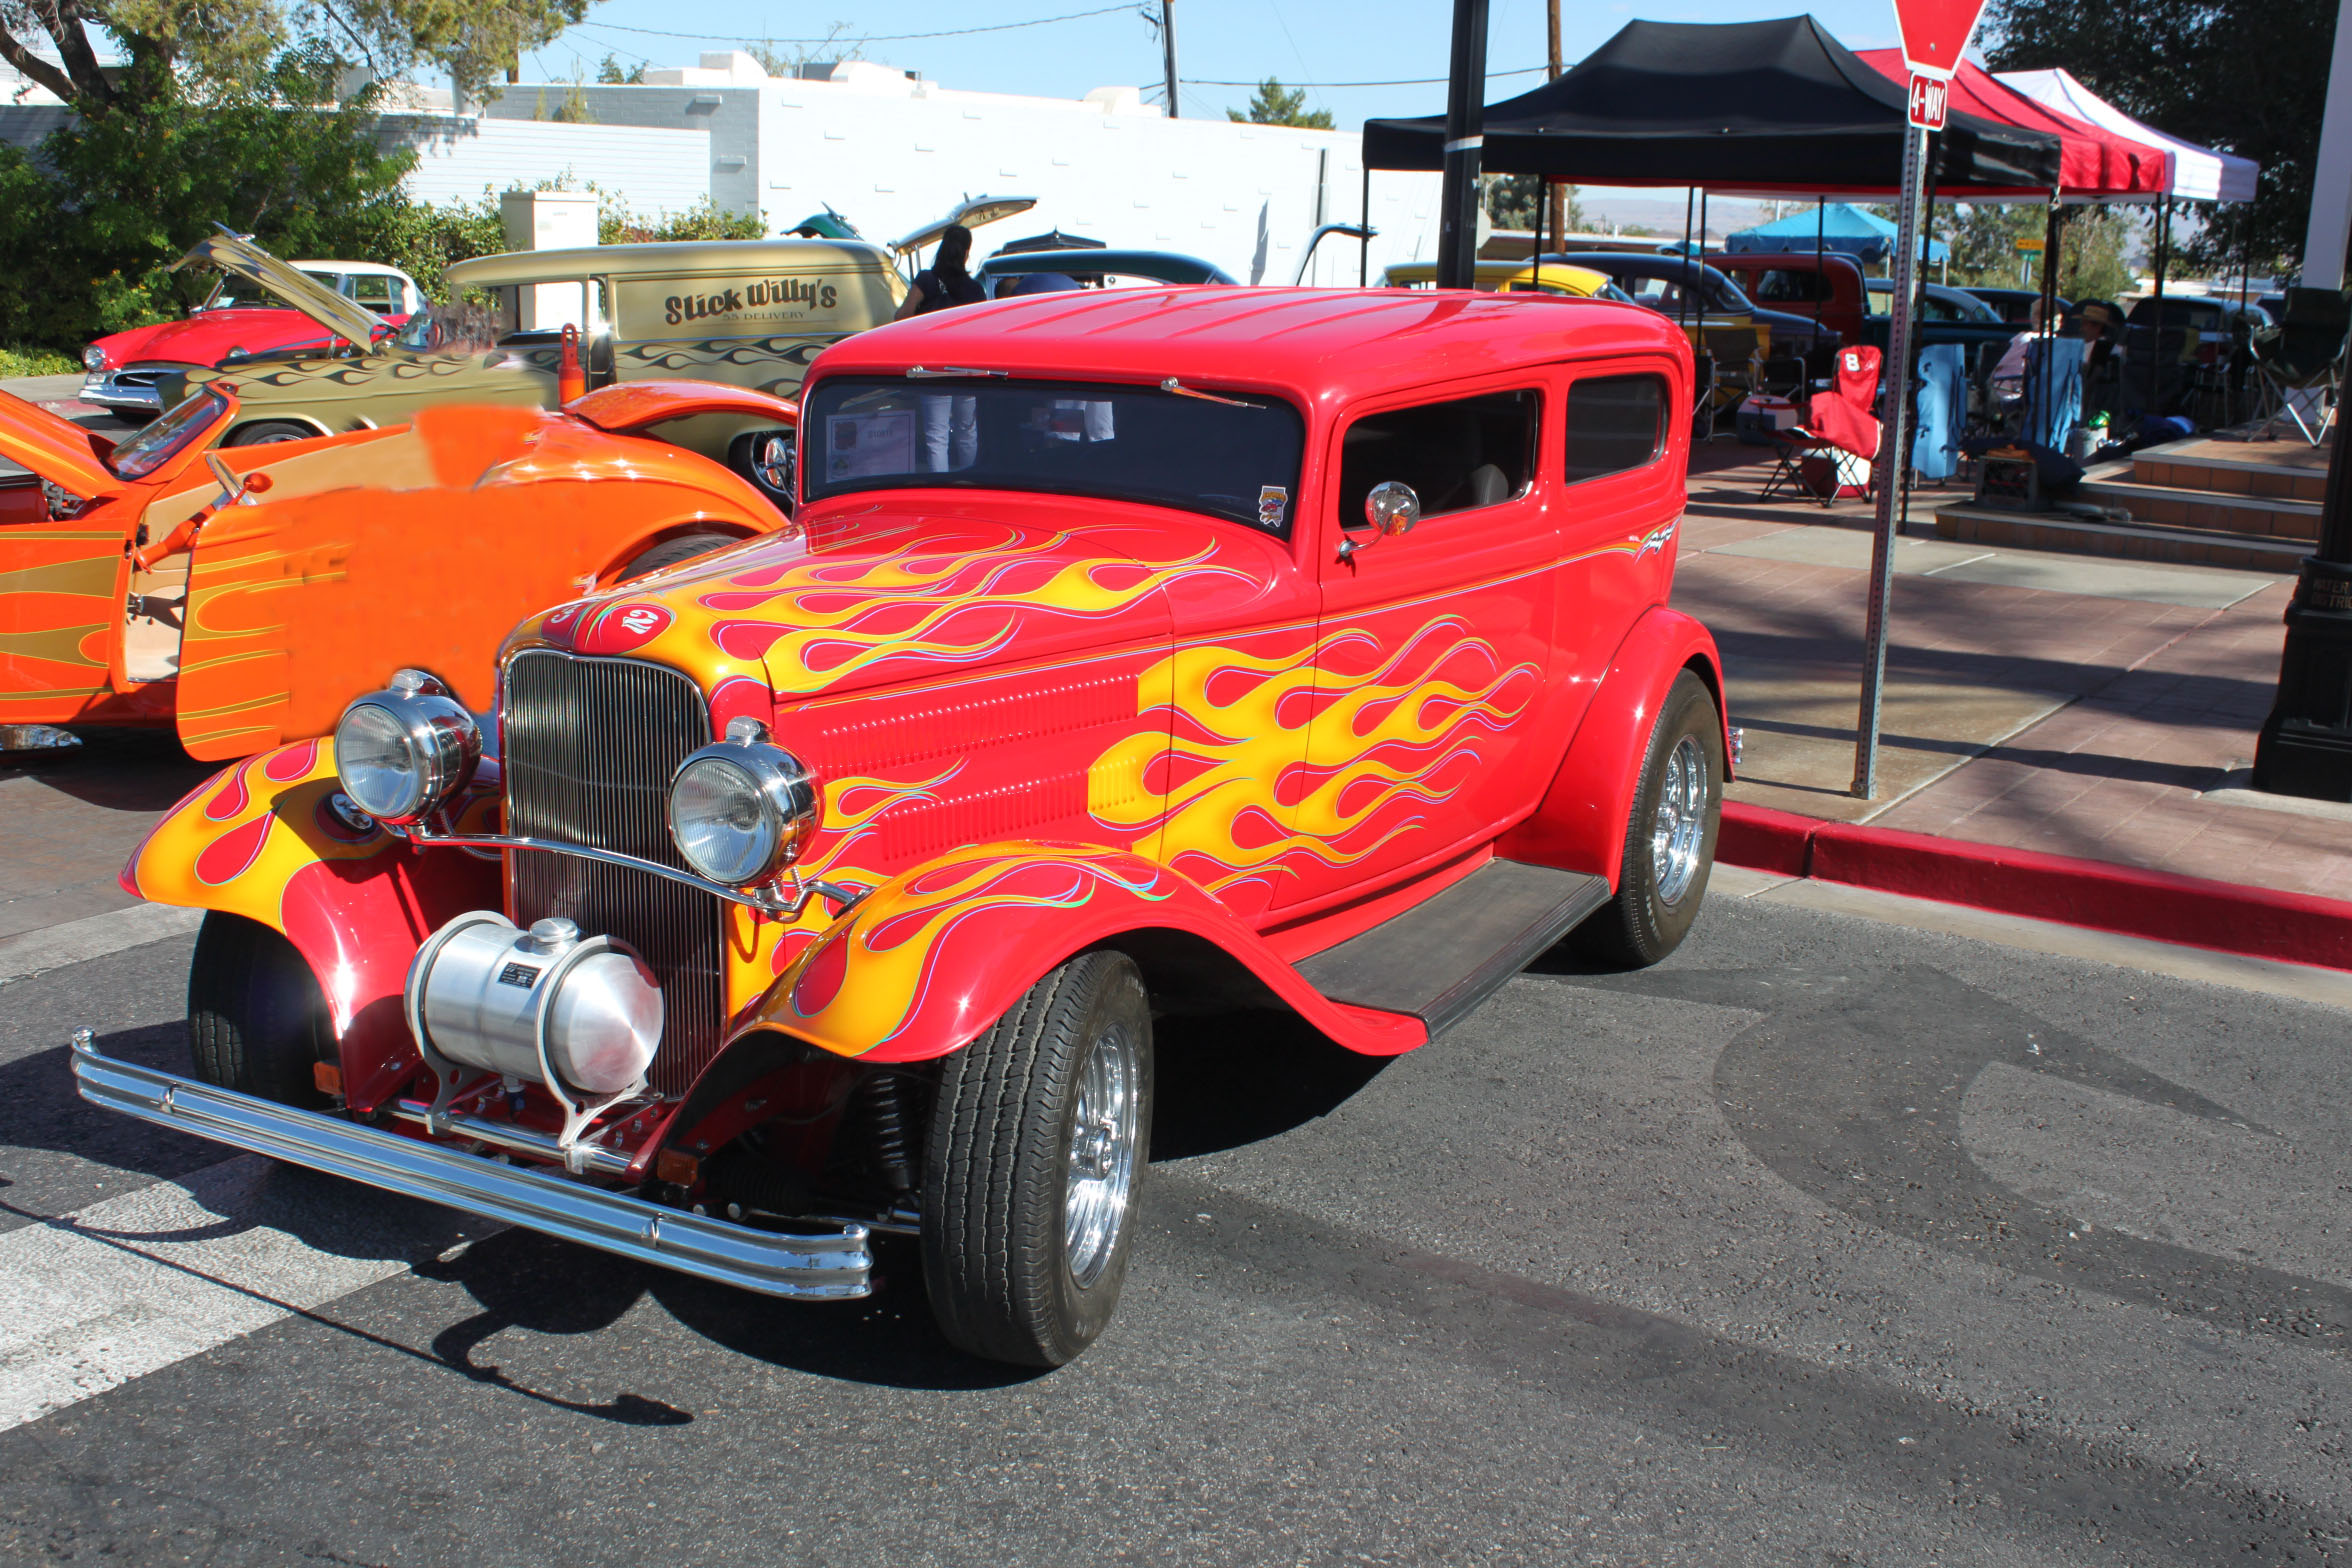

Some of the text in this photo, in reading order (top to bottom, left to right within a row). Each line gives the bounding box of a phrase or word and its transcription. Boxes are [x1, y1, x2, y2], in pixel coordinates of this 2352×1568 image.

[1911, 82, 1945, 121] 4-WAY
[665, 278, 837, 325] Slick Willy's
[743, 311, 806, 320] DELIVERY
[1845, 353, 1861, 372] 8
